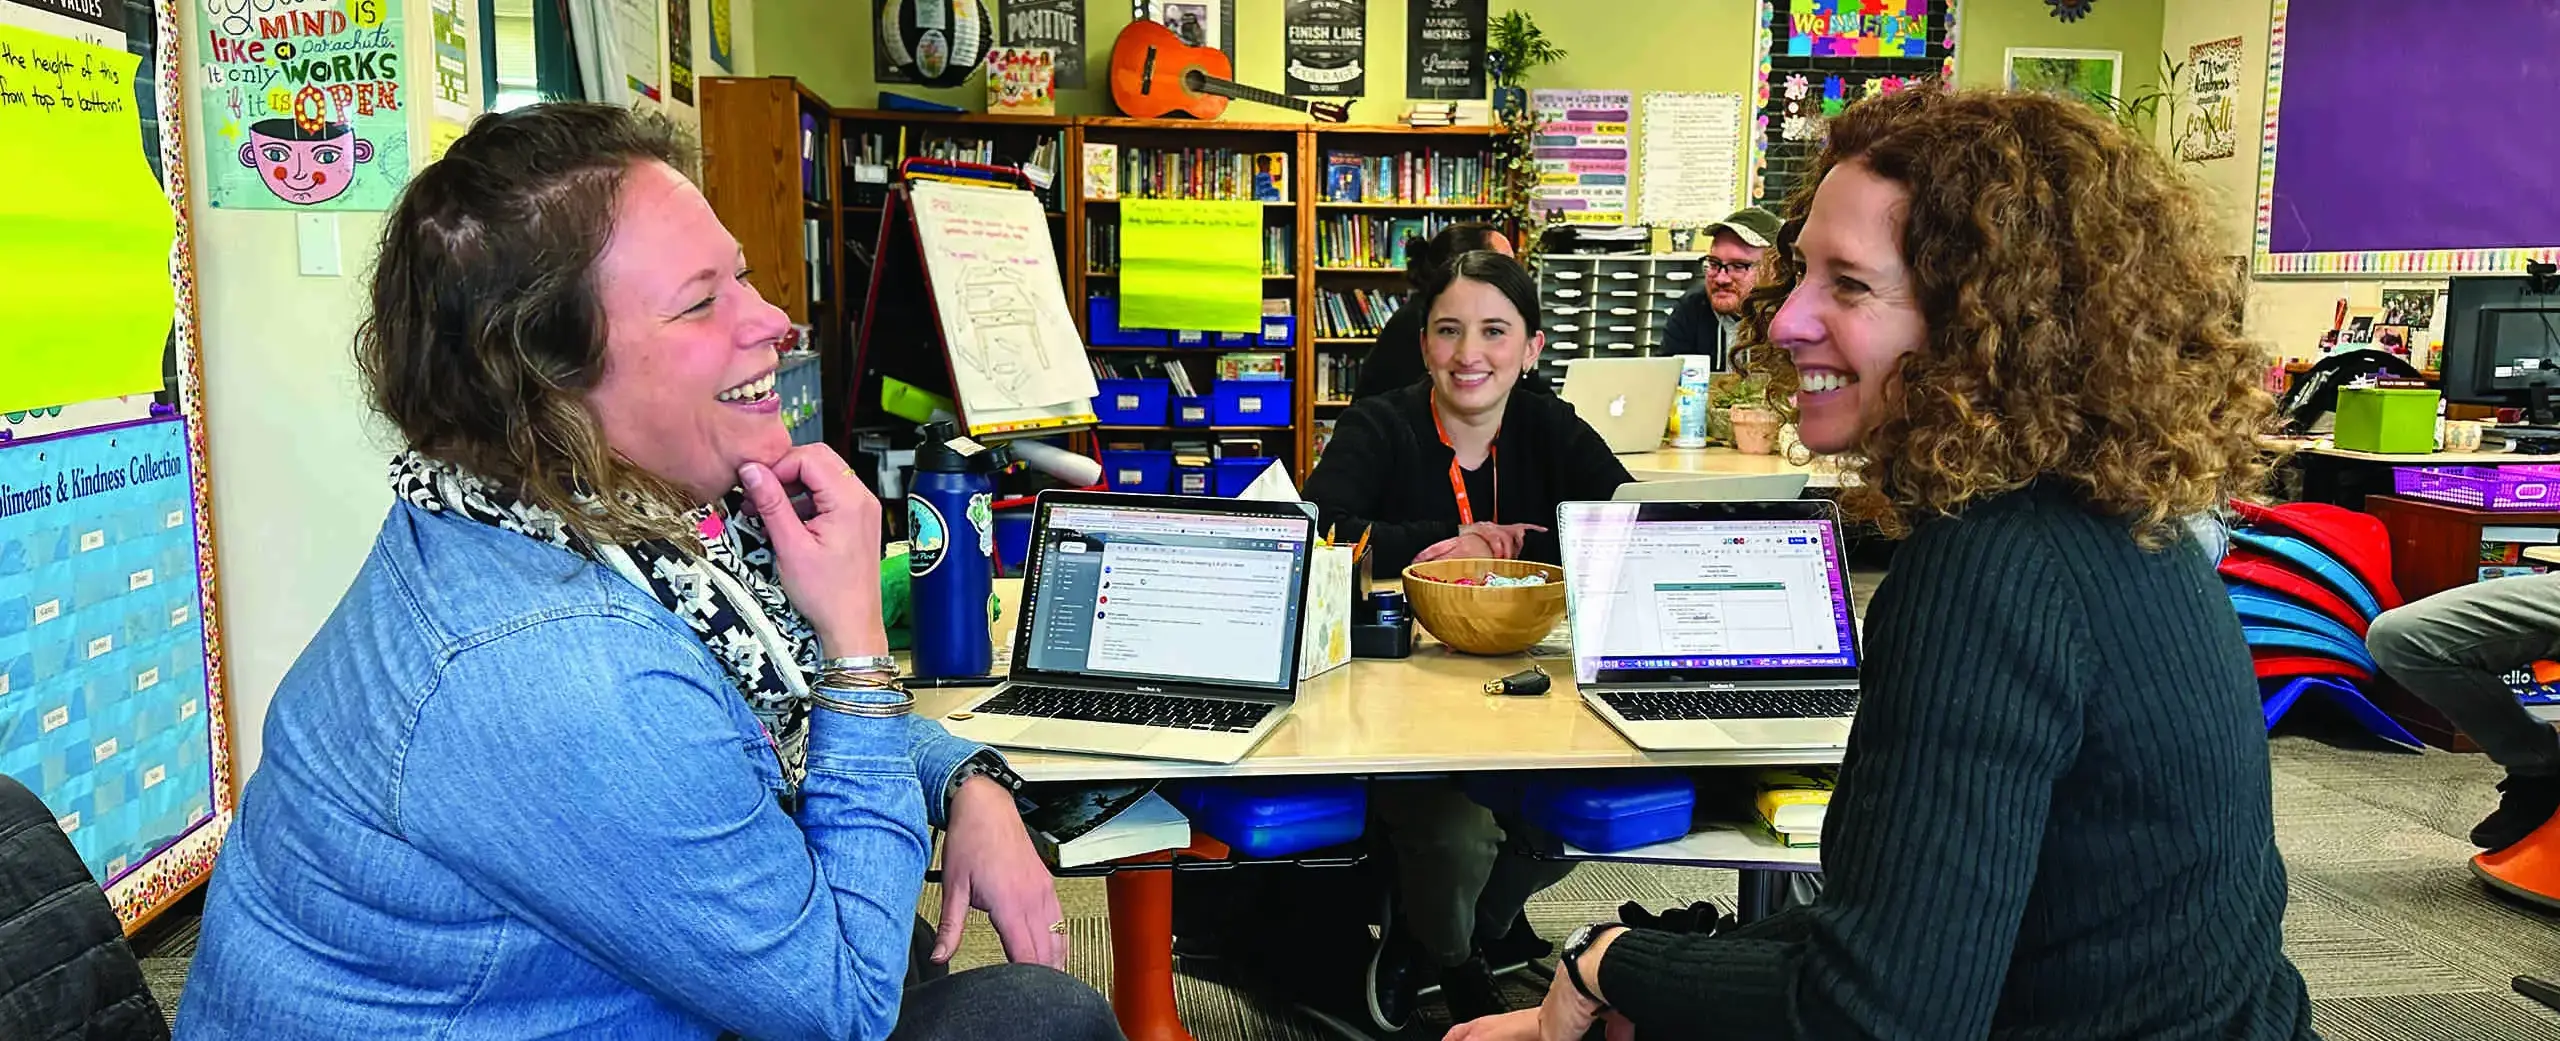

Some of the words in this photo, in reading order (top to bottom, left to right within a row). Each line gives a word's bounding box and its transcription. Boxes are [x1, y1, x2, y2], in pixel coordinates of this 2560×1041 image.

[60, 0, 103, 18] VALUES
[258, 9, 346, 40] MIND
[354, 0, 377, 24] IS
[1425, 18, 1468, 28] MAKING
[1007, 9, 1078, 45] POSITIVE
[1289, 26, 1330, 40] FINISH
[1333, 26, 1363, 40] LINE
[1422, 28, 1471, 40] MISTAKES
[1793, 12, 1825, 36] We
[209, 29, 266, 64] like
[2, 42, 26, 69] the
[32, 49, 74, 89] height
[82, 53, 93, 81] of
[99, 60, 119, 85] this
[228, 65, 280, 91] only
[281, 50, 397, 84] WORKS
[1294, 67, 1356, 82] COURAGE
[32, 85, 55, 113] top
[61, 89, 74, 108] to
[226, 86, 242, 119] if
[249, 94, 266, 117] it
[270, 93, 291, 113] IS
[293, 80, 403, 136] OPEN.
[56, 470, 70, 503] &
[71, 463, 126, 500] Kindness
[129, 450, 181, 486] Collection
[2498, 669, 2531, 685] ello
